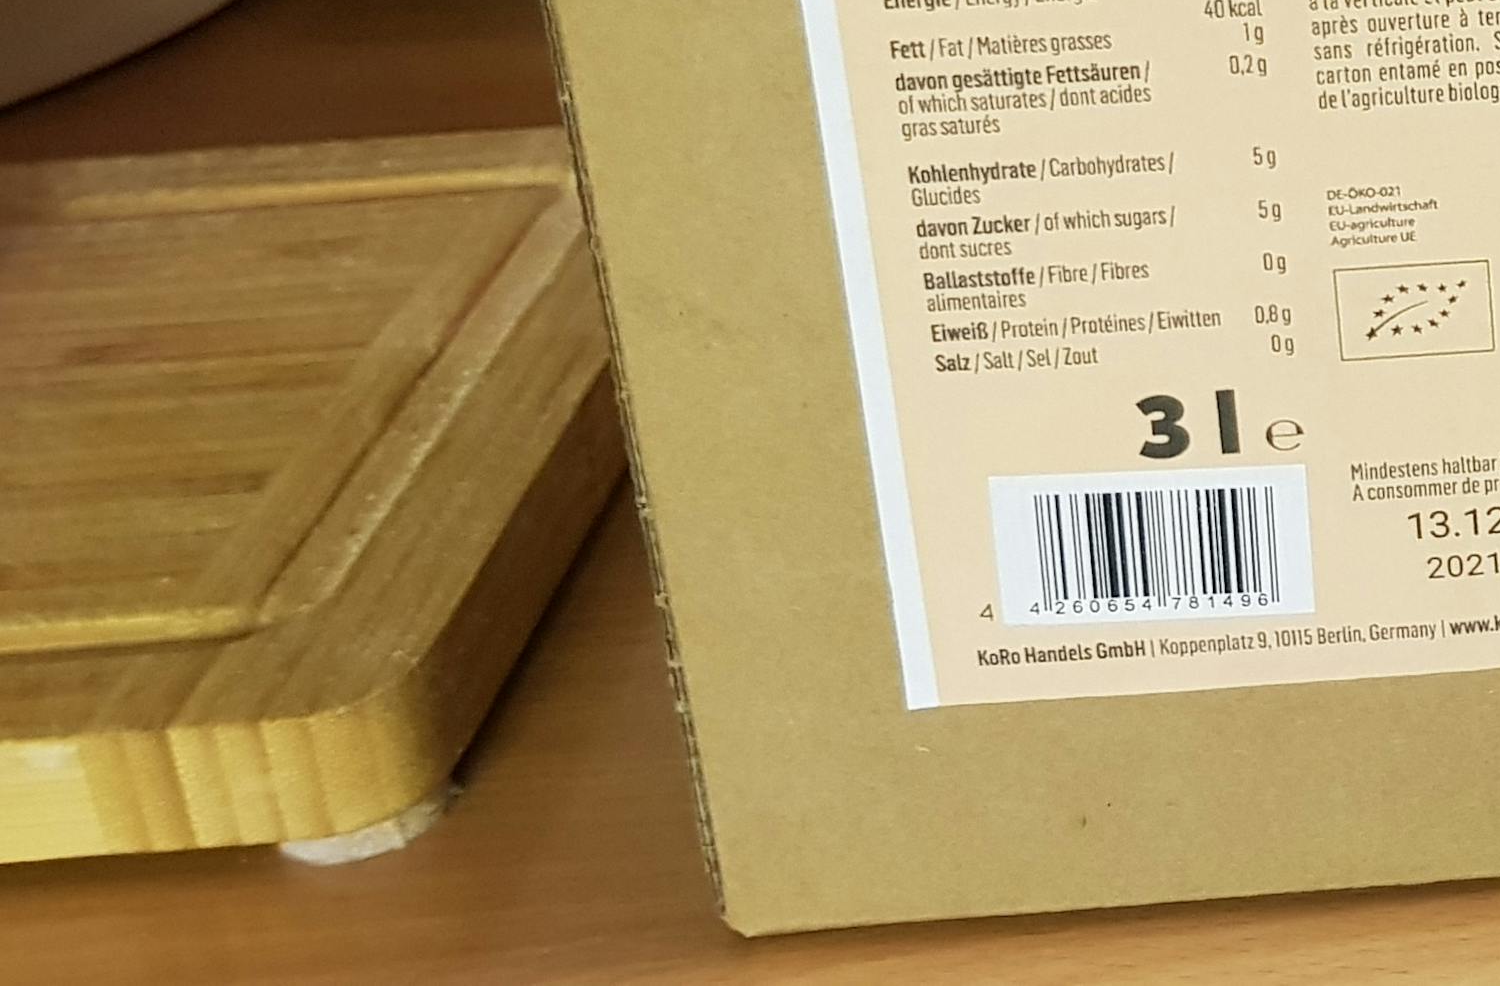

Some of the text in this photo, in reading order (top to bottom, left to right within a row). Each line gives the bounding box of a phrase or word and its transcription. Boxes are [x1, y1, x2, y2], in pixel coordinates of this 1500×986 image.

[1311, 15, 1358, 39] après
[1367, 12, 1450, 33] ouverture
[889, 34, 1112, 59] Fett Fat Matières grasses
[895, 63, 1141, 98] davon gesättigte Fettsäuren
[917, 83, 1152, 113] which saturates dont acides
[907, 154, 1165, 185] Kohlenhydrate Carbohydrates
[911, 185, 981, 207] Glucides
[1326, 185, 1401, 201] DE-ÖKO-021
[1328, 199, 1438, 216] EU-Landwirtschaft
[916, 210, 1167, 238] davon Zucker which sugars
[1329, 216, 1416, 232] EU-agriculture
[1330, 231, 1416, 248] Agriculture UE
[923, 262, 1149, 291] Ballaststoffe Fibre Fibres
[930, 309, 1221, 343] Eiweiß Protein Protéines Eiwitten
[934, 347, 1098, 372] Salz Salt Sel Zout
[1135, 389, 1241, 460] 3 l
[1350, 462, 1438, 481] Mindestens
[1442, 455, 1497, 475] haltbar
[1367, 481, 1458, 501] consommer
[977, 648, 1021, 666] KoRo
[1023, 643, 1093, 664] Handels
[1095, 639, 1146, 659] GmbH
[1159, 634, 1255, 657] Koppenplatz
[1274, 628, 1313, 648] 10115
[1316, 625, 1366, 645] Berlin,
[1369, 623, 1437, 641] Germany
